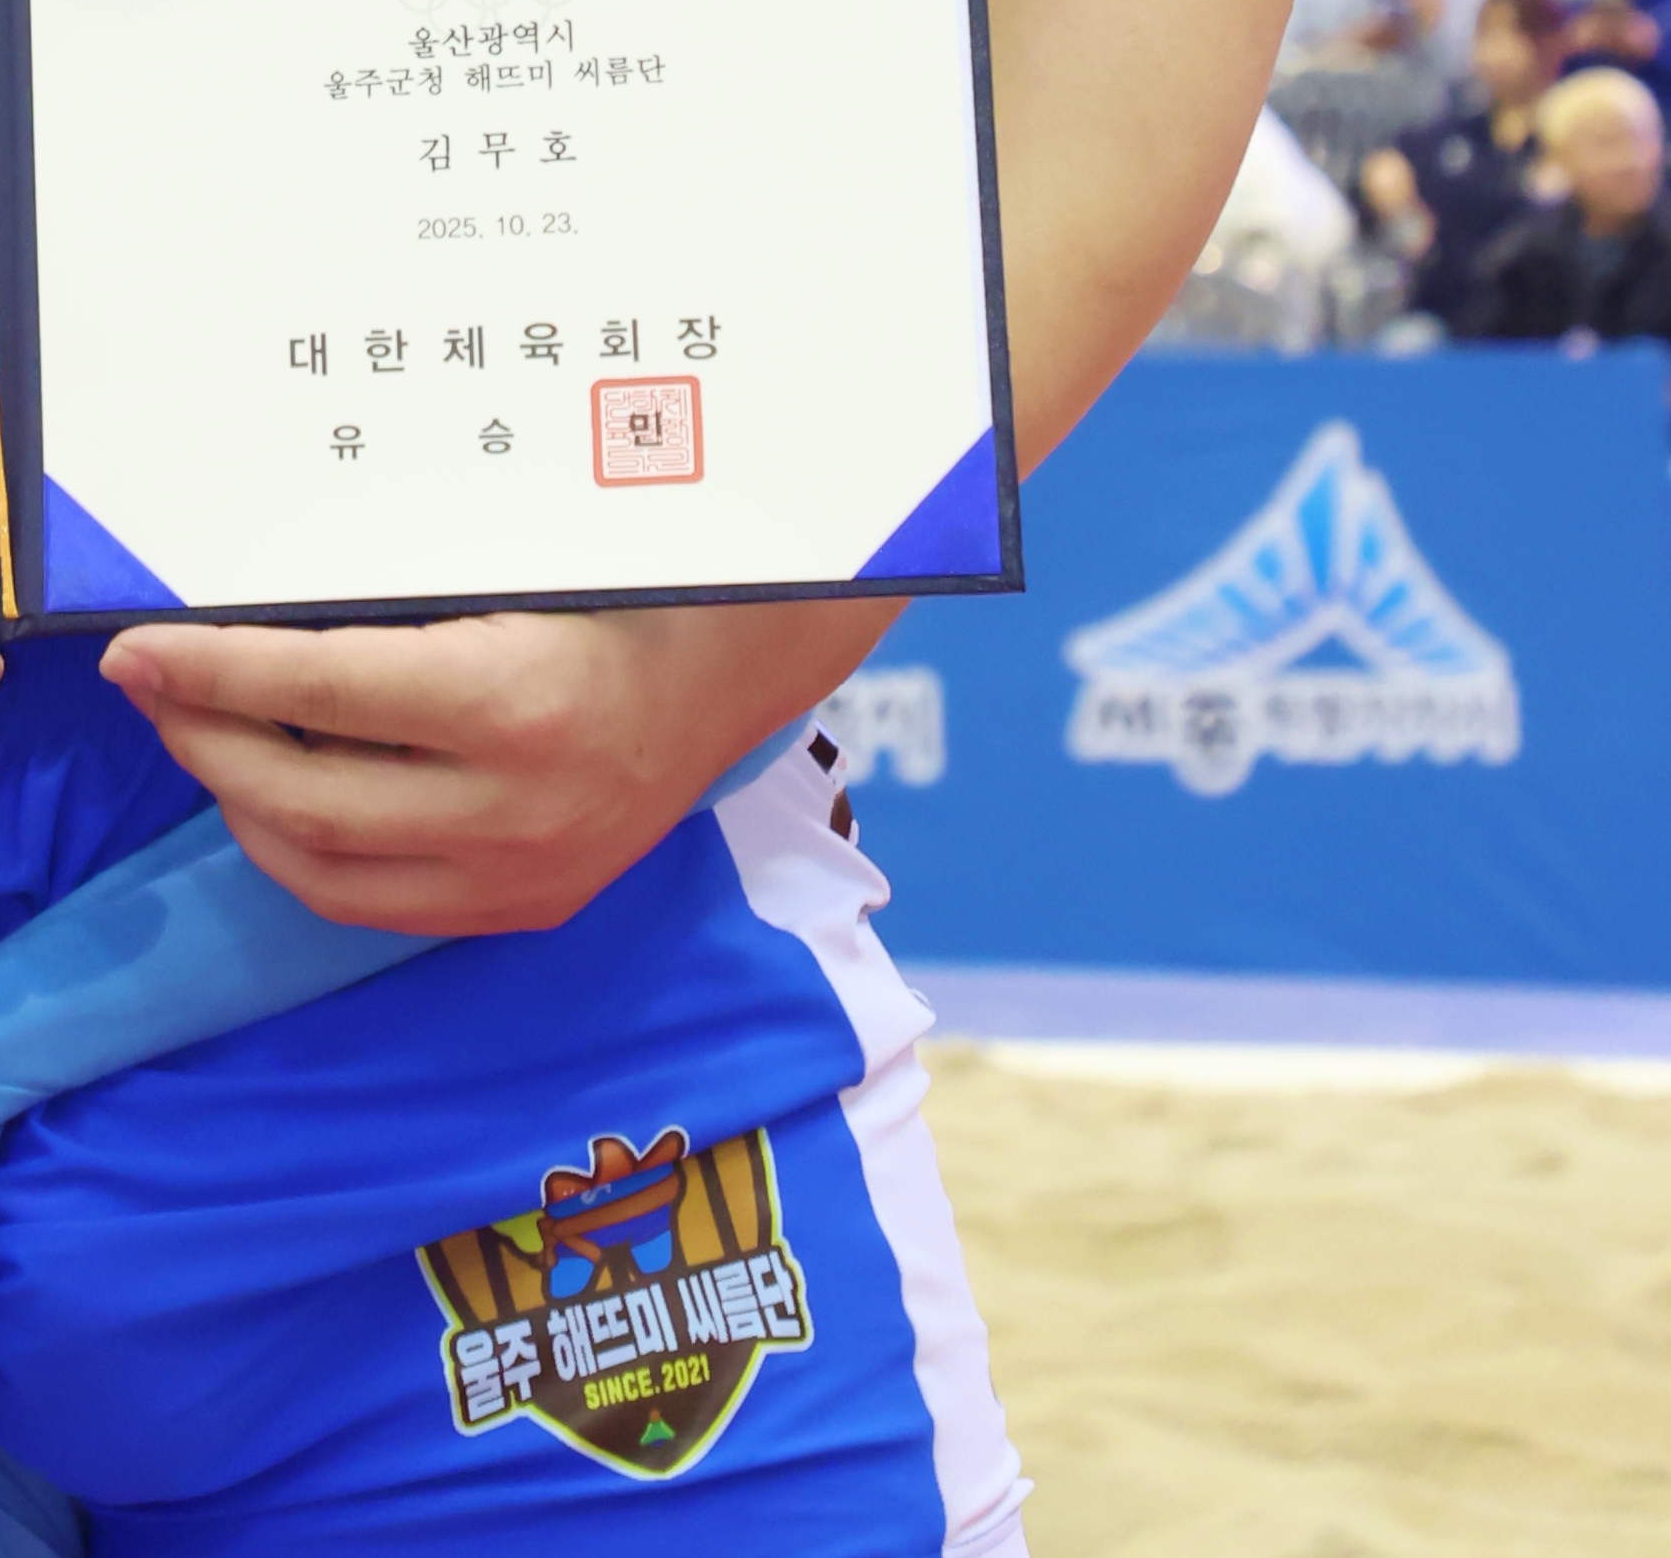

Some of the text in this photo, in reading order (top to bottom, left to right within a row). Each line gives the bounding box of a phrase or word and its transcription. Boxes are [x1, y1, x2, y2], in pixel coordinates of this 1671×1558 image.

[407, 18, 575, 61] 울산광역시
[323, 53, 667, 101] 울주군청 해뜨미 씨름단
[417, 212, 579, 240] 2025. 10. 23.
[329, 424, 366, 461] 유
[477, 417, 515, 456] 승
[455, 1252, 801, 1423] 울주 해뜨미 씨름단
